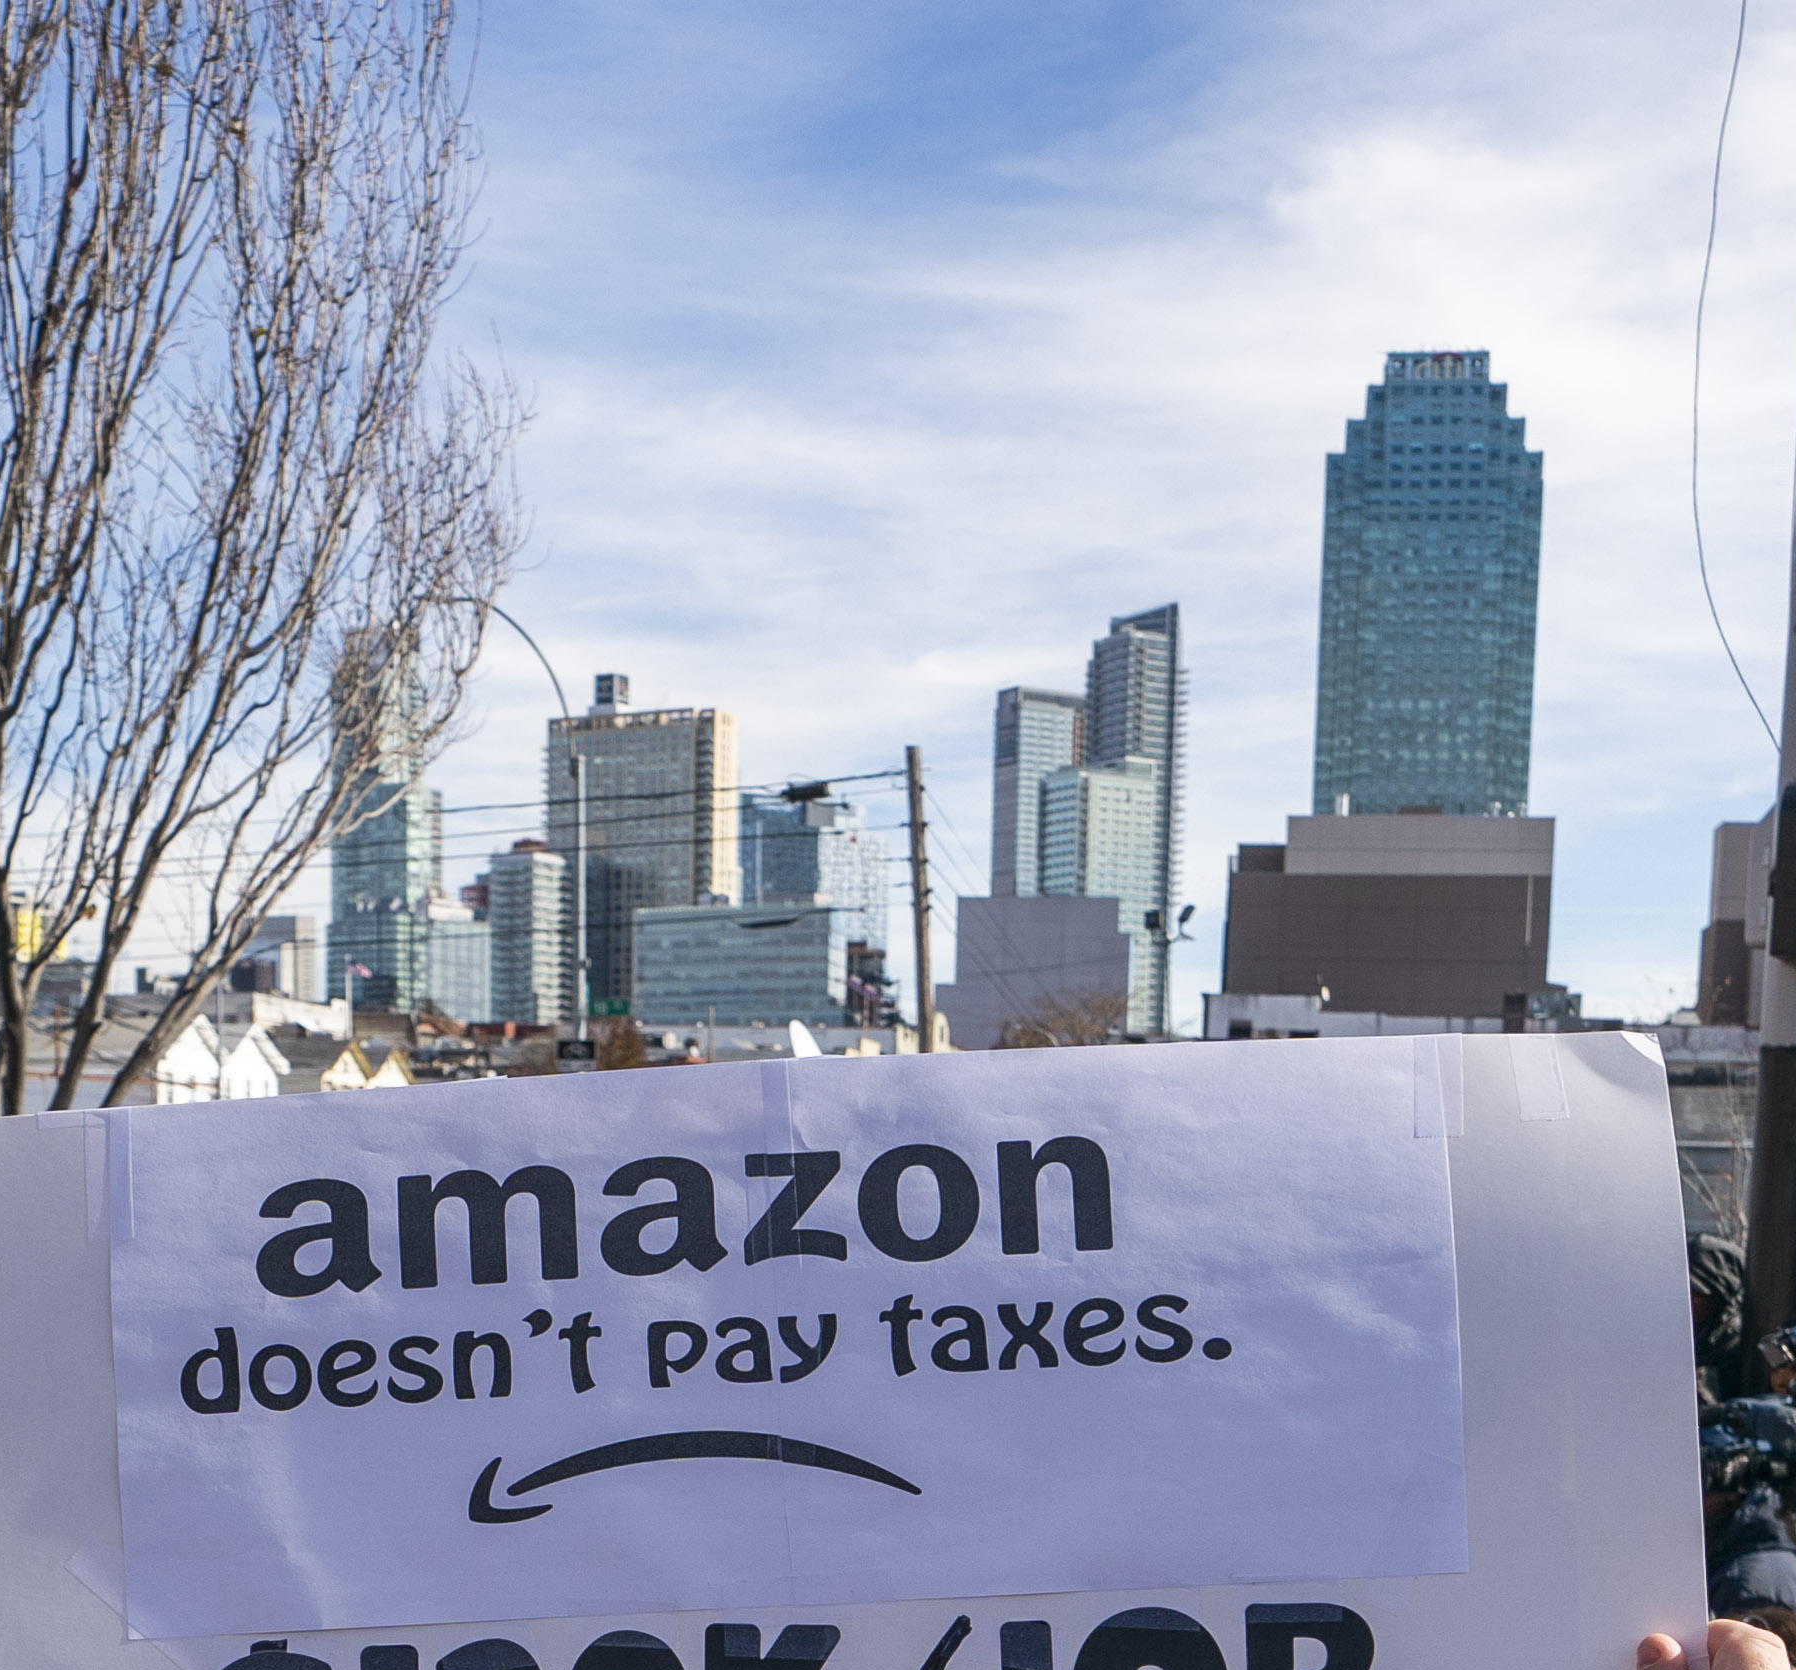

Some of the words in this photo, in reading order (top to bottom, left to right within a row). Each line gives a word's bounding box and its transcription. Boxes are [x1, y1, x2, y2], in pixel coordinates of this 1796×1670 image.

[254, 1134, 1115, 1299] amazon
[178, 1308, 604, 1416] doesn't
[645, 1312, 839, 1390] pay
[877, 1292, 1234, 1379] taxes.
